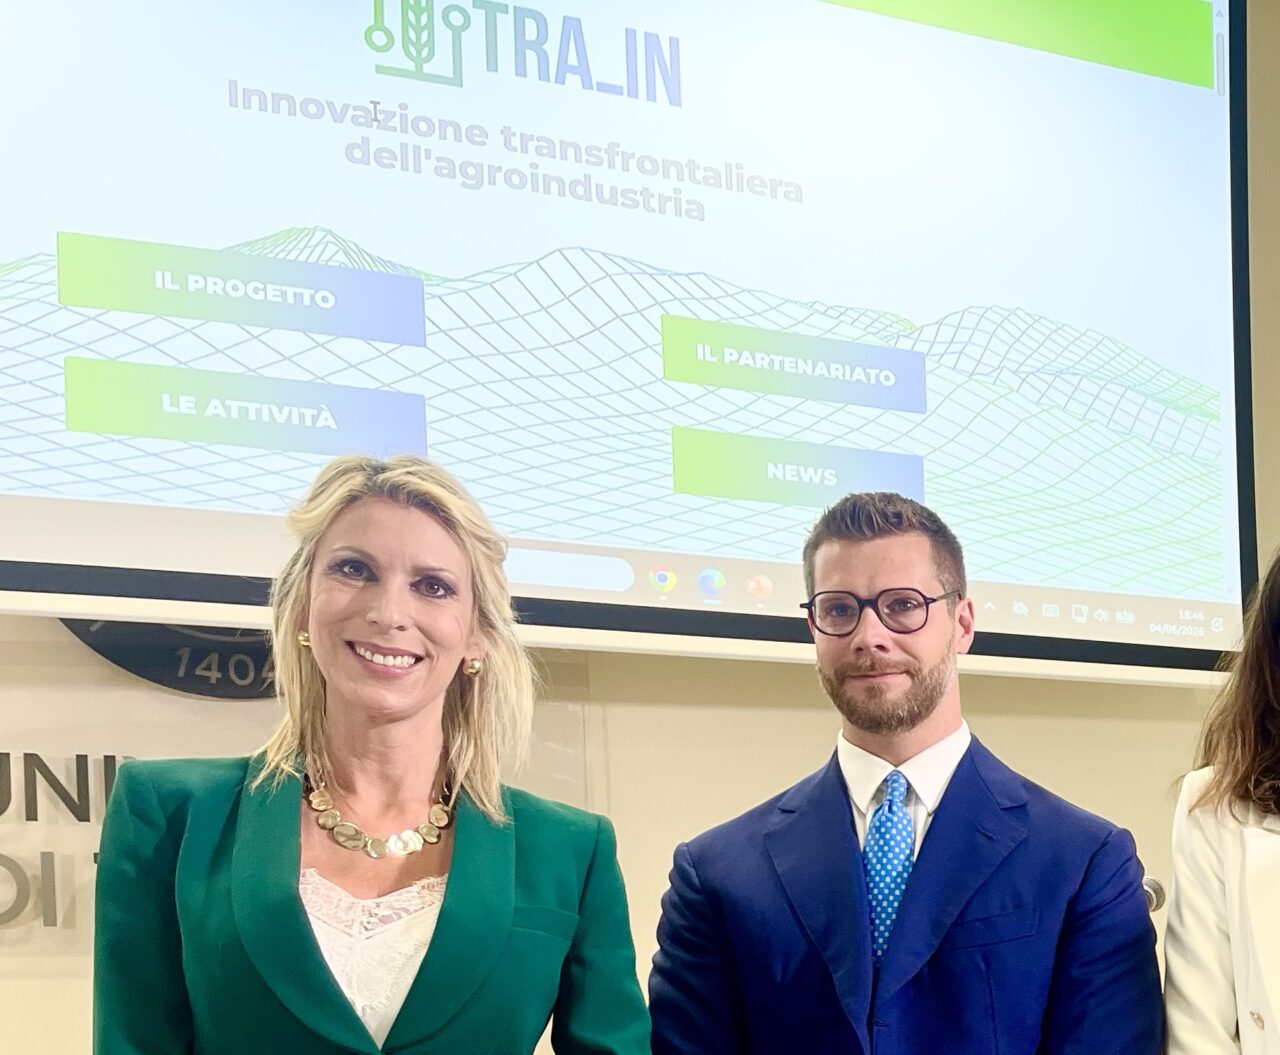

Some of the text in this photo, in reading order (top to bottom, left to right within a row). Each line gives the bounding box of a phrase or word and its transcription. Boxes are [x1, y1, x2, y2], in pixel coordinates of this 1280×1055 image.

[472, 0, 682, 108] TRA_IN
[227, 78, 804, 204] Innovazione transfrontaliera
[344, 135, 706, 222] dell'agroindustria
[154, 269, 337, 309] IL PROGETTO
[696, 343, 897, 387] IL PARTENARIATO
[161, 392, 339, 430] LE ATTIVITÀ
[766, 461, 839, 486] NEWS
